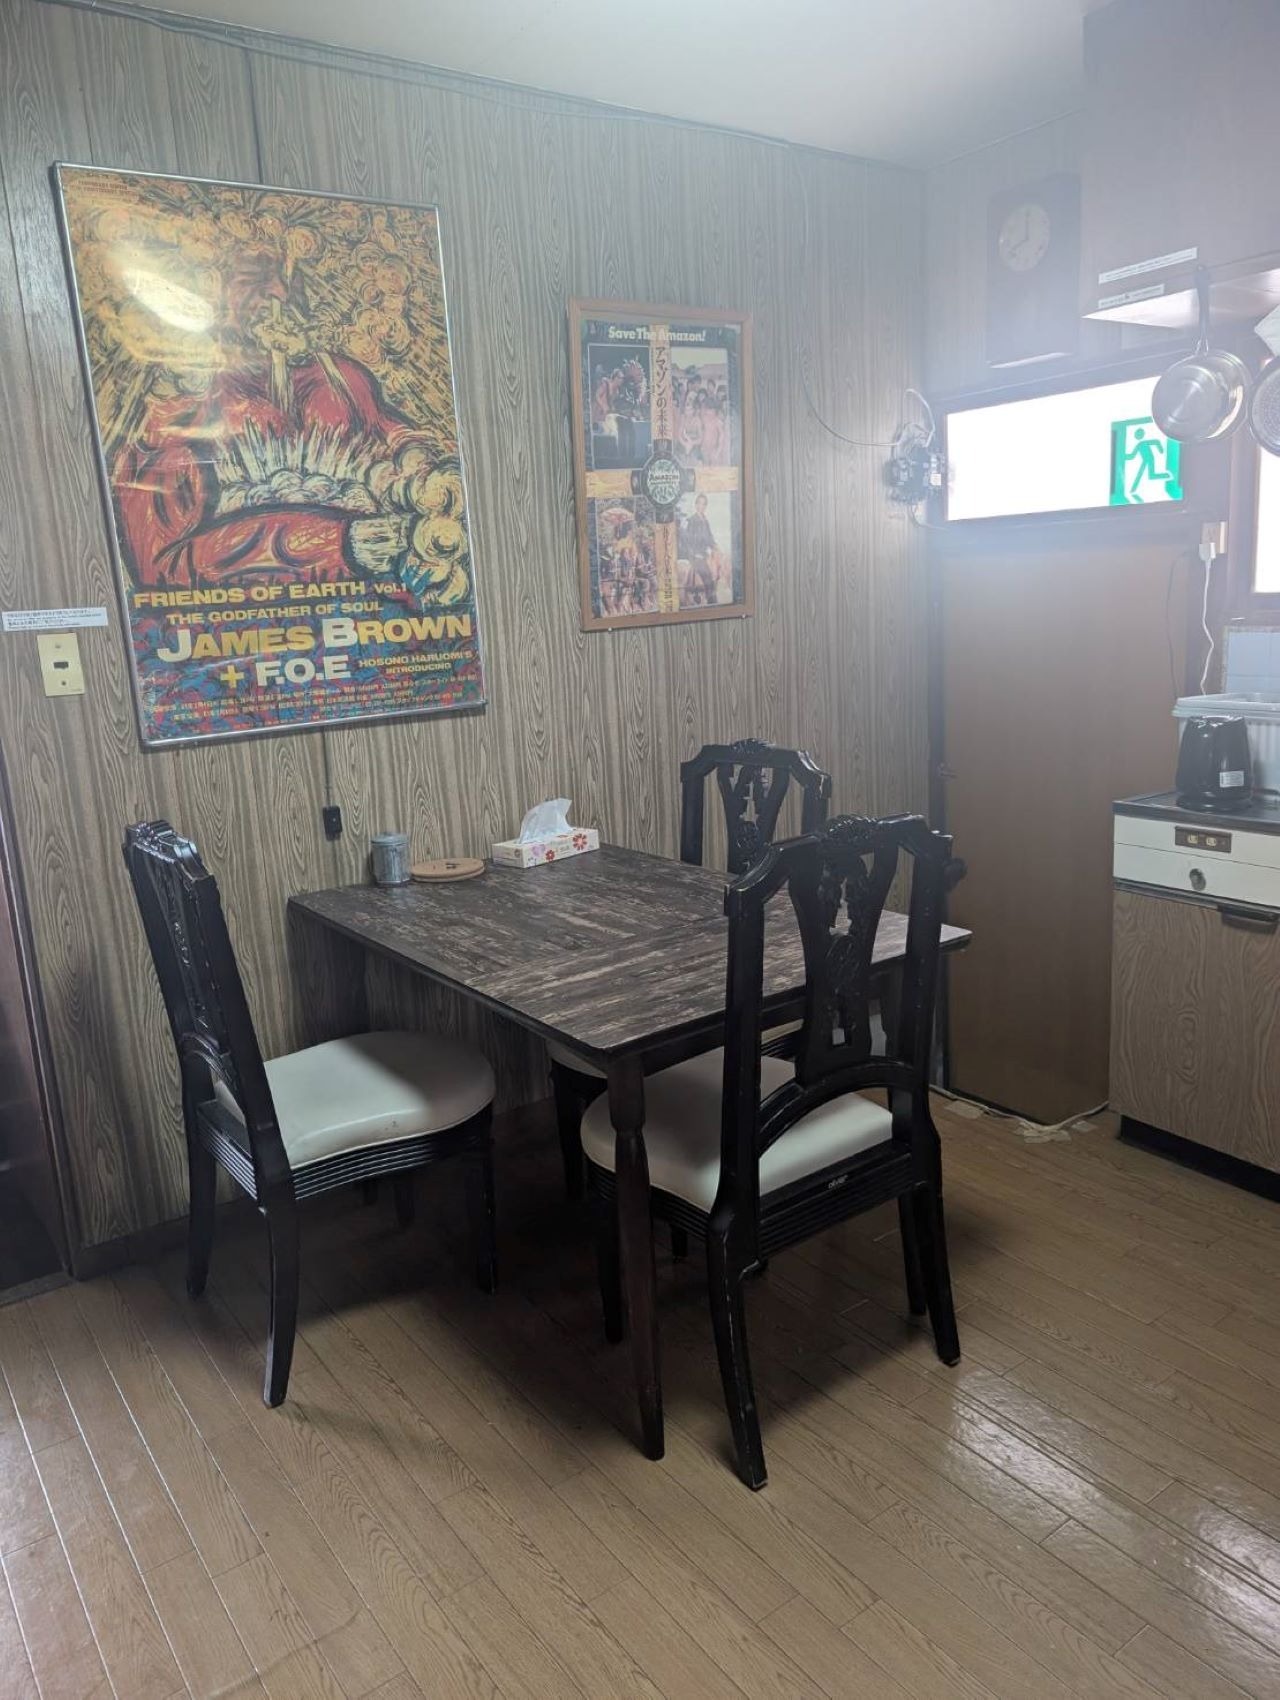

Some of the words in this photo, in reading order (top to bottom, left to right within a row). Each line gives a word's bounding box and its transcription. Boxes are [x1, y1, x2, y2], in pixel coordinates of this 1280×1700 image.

[608, 325, 636, 340] Save
[133, 588, 245, 609] FRIENDS
[251, 585, 283, 601] OF
[289, 581, 367, 599] EARTH
[166, 612, 205, 625] THE
[208, 604, 311, 622] GODFATHER
[315, 603, 337, 615] OF
[342, 600, 385, 613] SOUL
[157, 625, 316, 662] JAMES
[322, 613, 472, 648] BROWN
[255, 654, 351, 686] F.O.E
[359, 655, 409, 668] HOSONO
[386, 662, 452, 674] INTRODUCING
